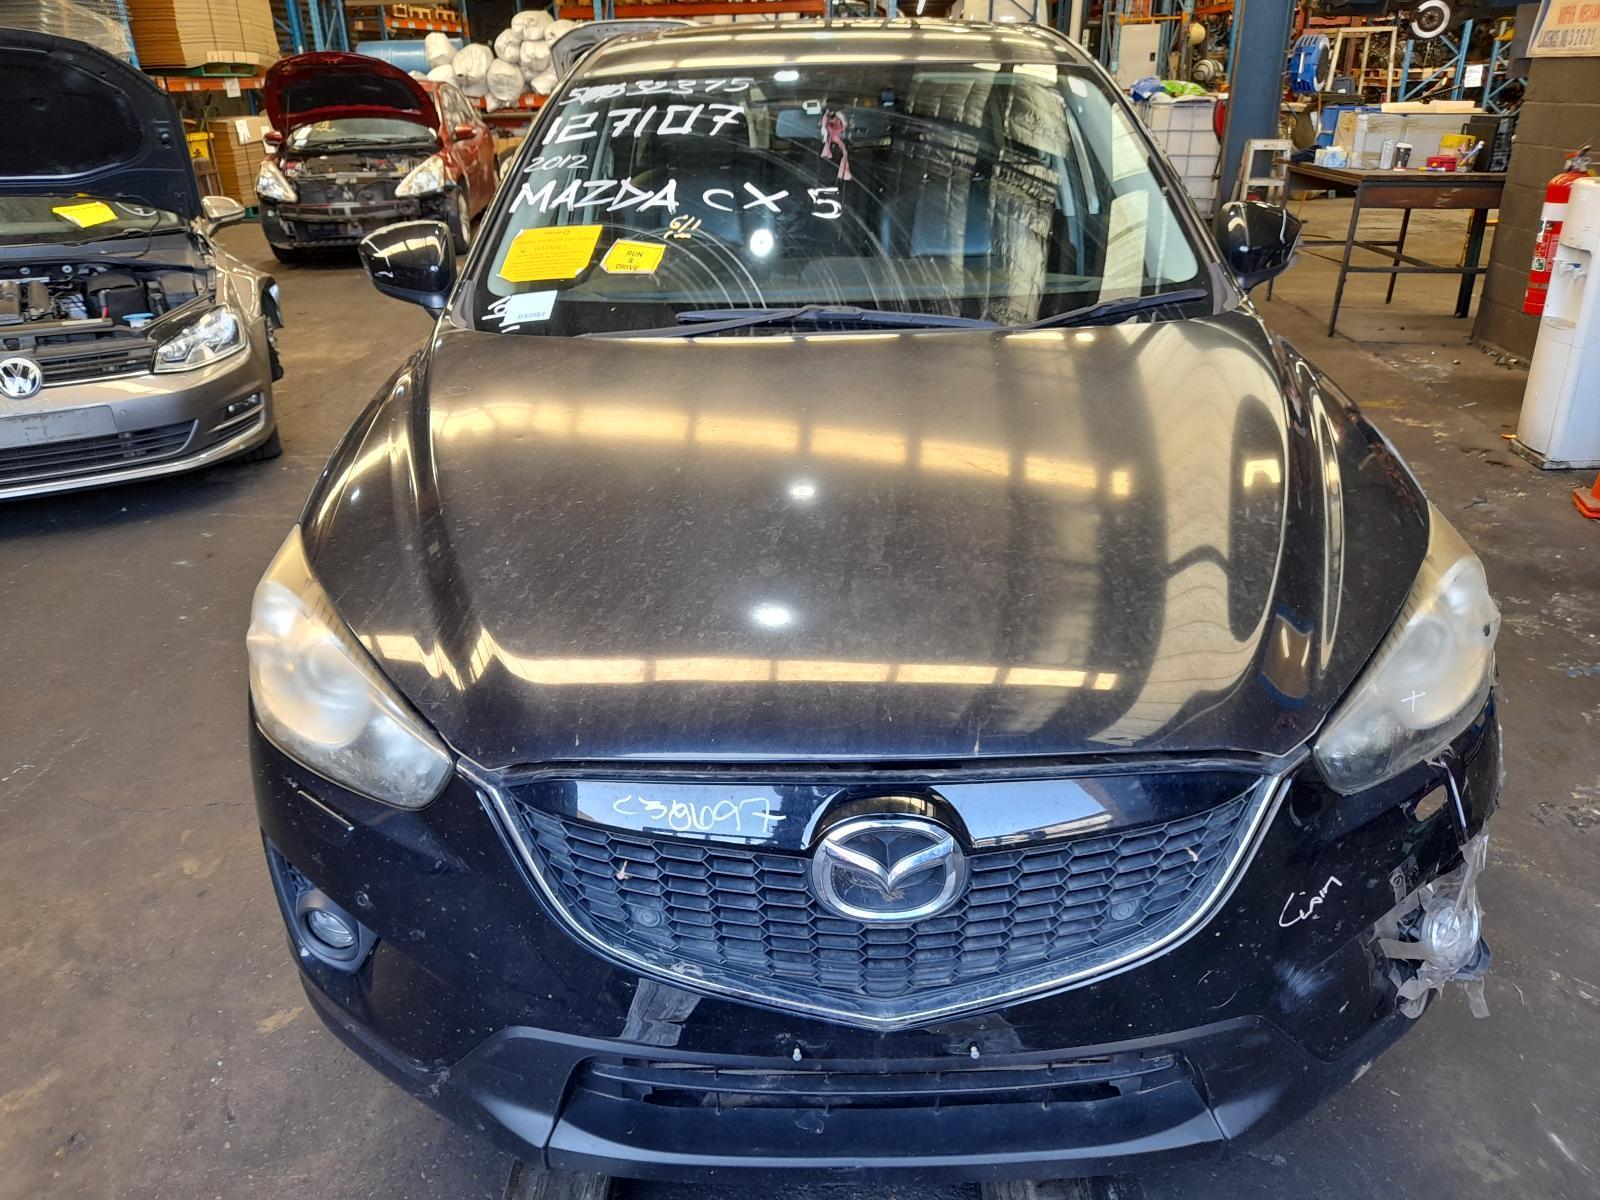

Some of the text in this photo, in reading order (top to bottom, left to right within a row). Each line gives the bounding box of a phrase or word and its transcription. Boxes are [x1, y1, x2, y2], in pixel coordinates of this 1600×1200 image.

[542, 103, 745, 145] 127107
[524, 154, 588, 173] 2012
[508, 177, 680, 215] MAZDA
[807, 187, 841, 219] 5
[615, 263, 640, 271] DRIVE
